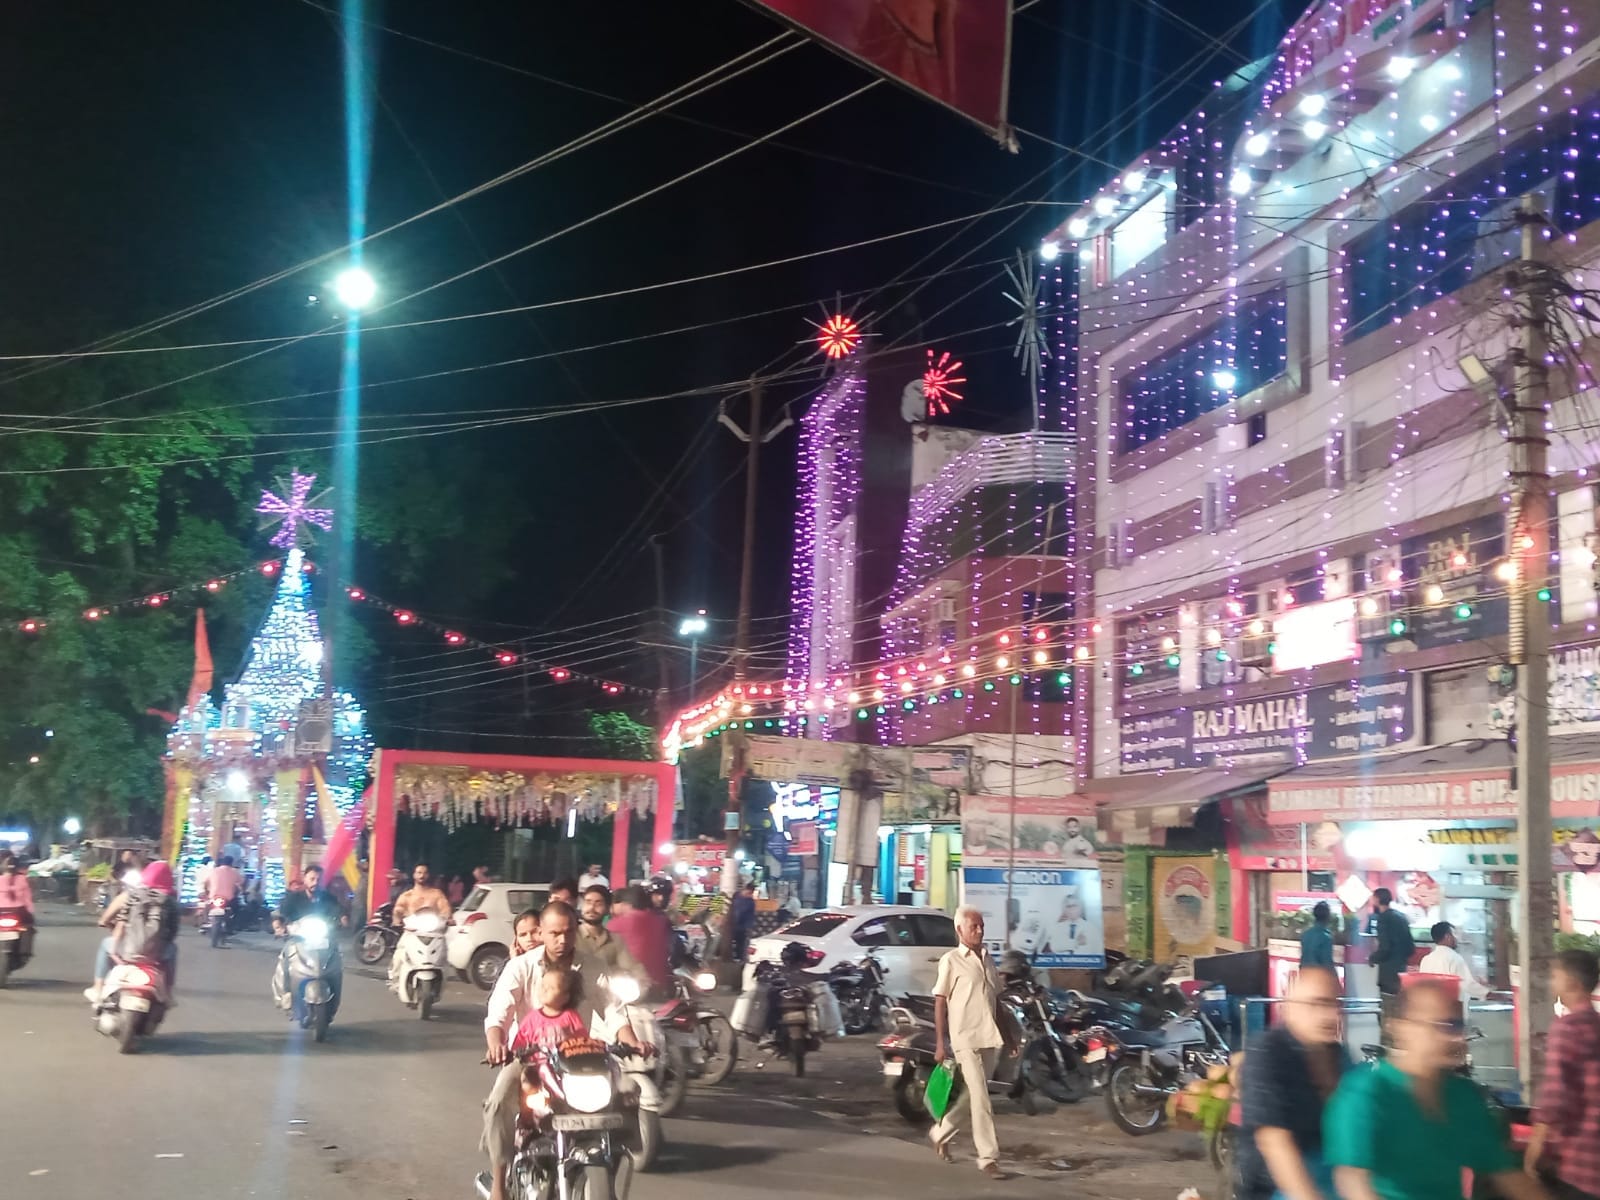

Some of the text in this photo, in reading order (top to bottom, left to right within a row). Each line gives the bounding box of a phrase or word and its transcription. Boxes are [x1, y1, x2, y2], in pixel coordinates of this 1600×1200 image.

[1192, 707, 1232, 738] RAJ
[1233, 696, 1315, 735] MAHAL
[1343, 781, 1449, 809] RESTAURANT
